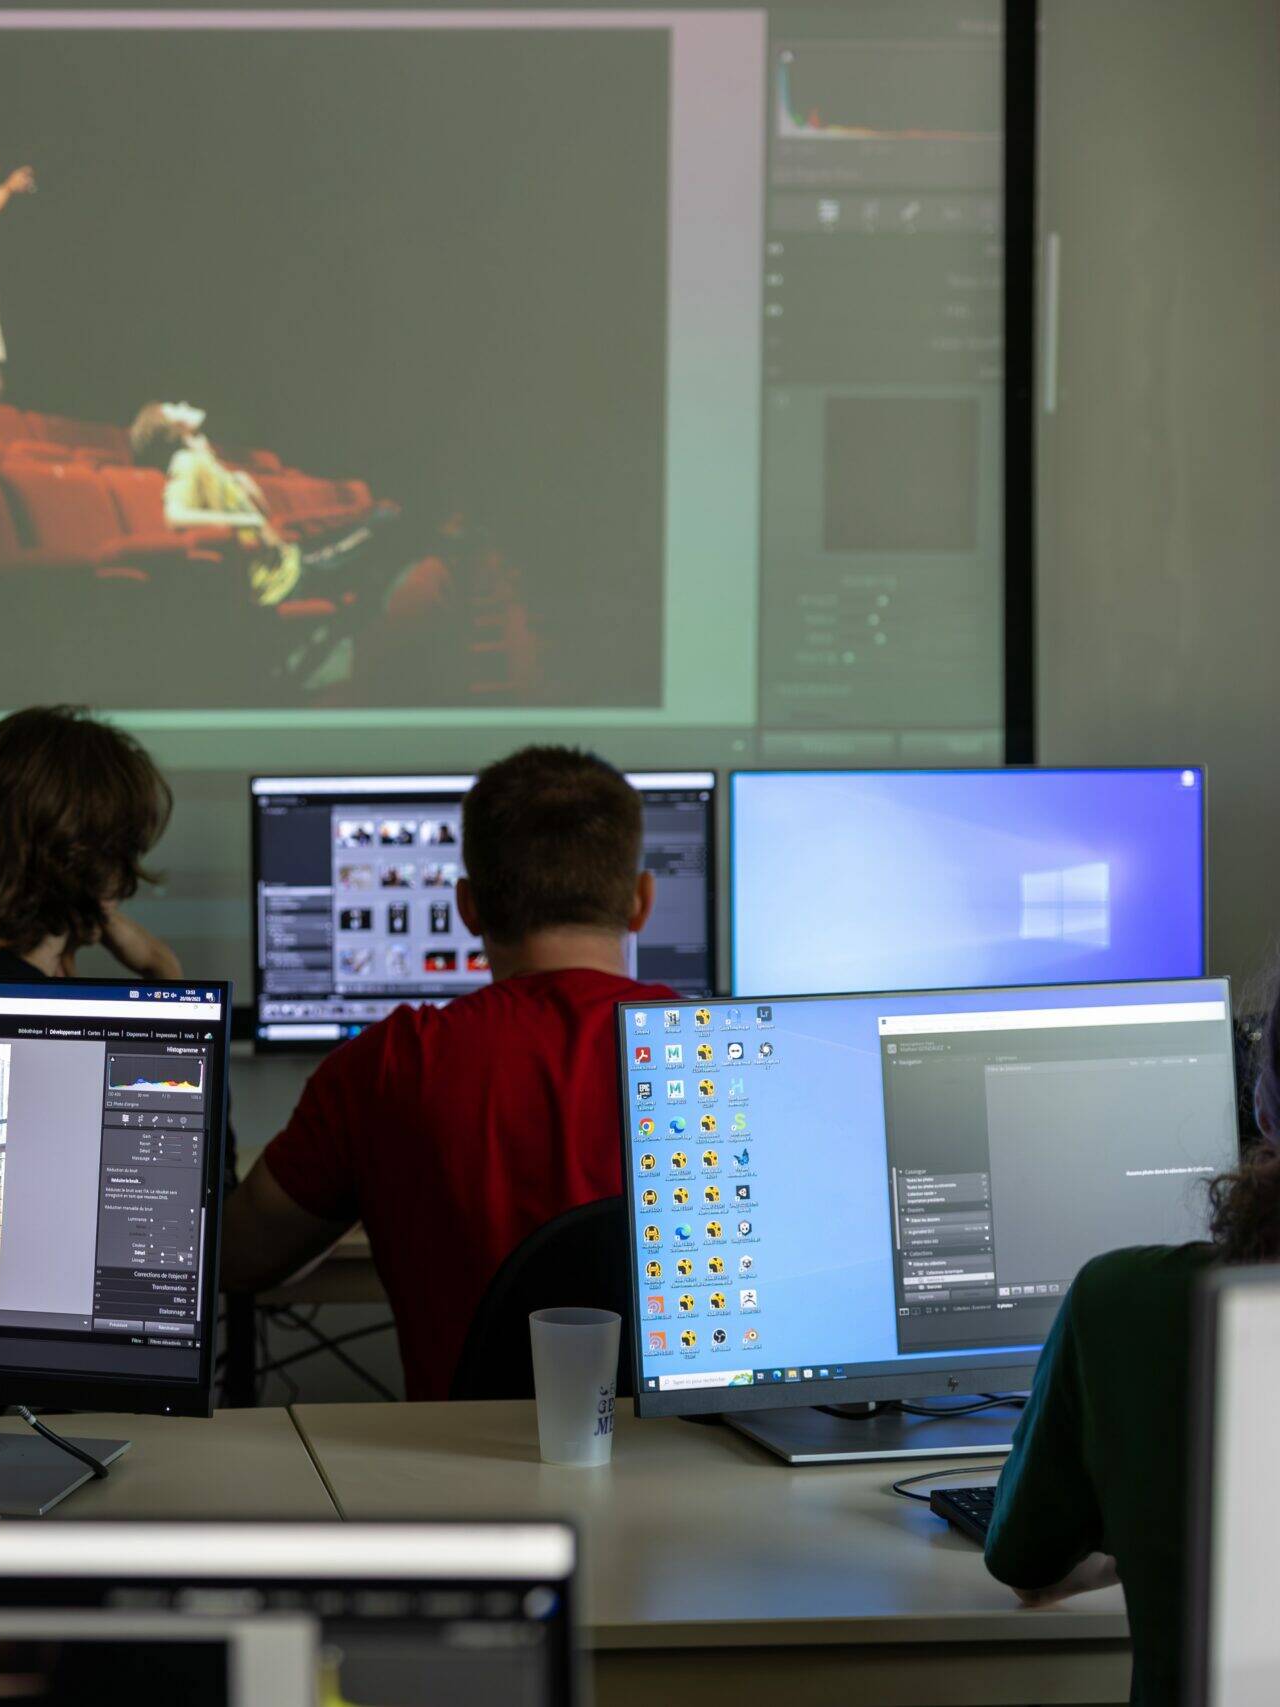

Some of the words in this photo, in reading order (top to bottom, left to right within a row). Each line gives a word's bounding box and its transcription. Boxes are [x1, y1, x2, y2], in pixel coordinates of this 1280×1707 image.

[759, 1009, 769, 1018] Lr
[166, 1046, 199, 1054] Histogramme
[152, 1283, 187, 1291] Transformation
